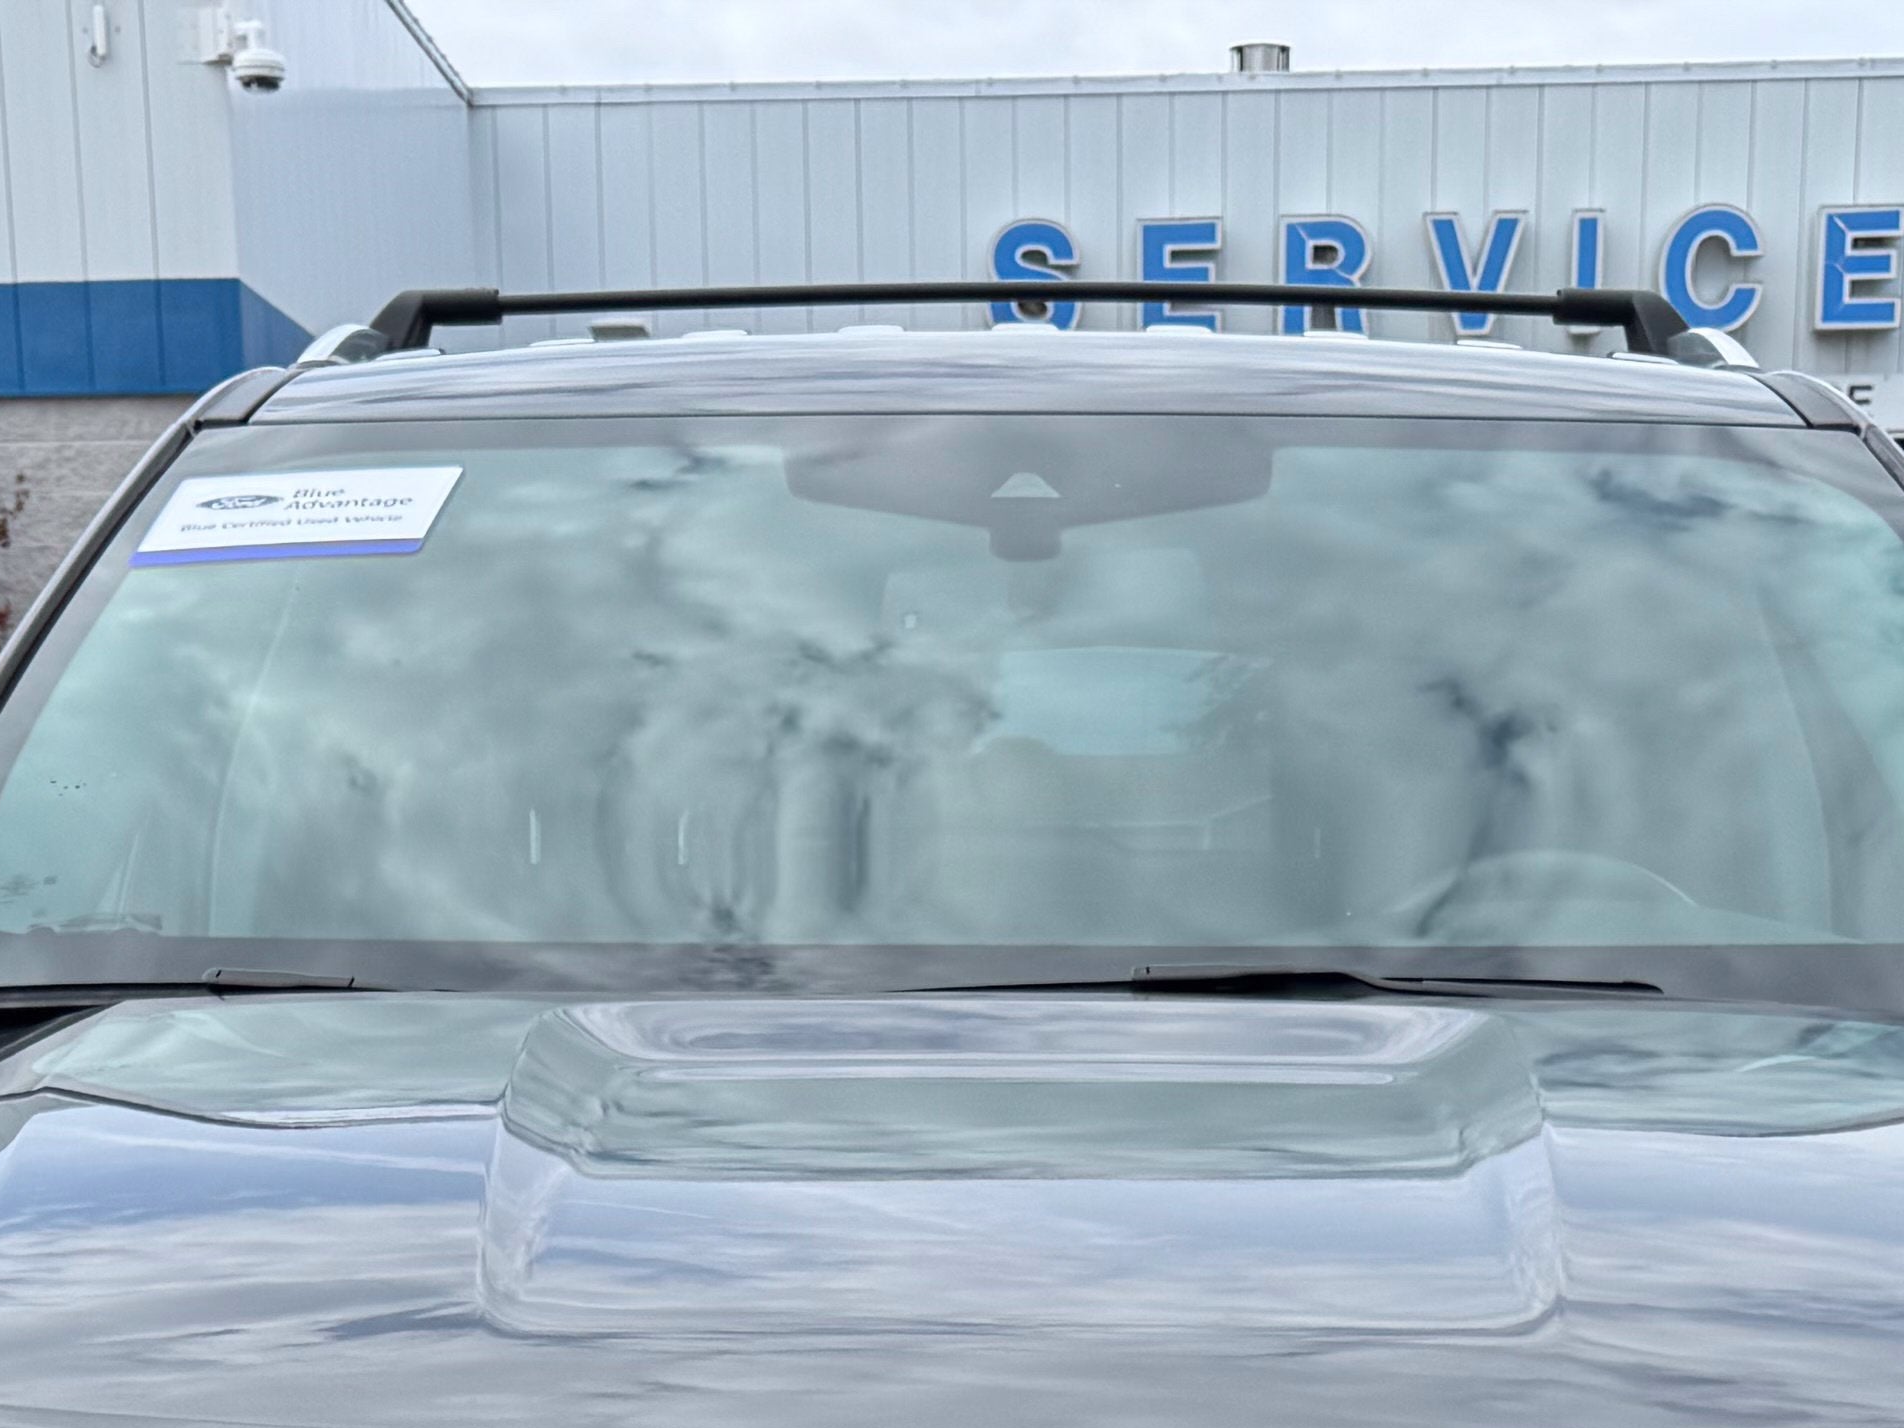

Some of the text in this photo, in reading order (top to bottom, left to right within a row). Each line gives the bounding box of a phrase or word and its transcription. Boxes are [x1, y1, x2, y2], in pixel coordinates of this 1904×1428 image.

[988, 204, 1904, 335] SERVICE
[292, 488, 345, 498] Blue
[284, 497, 413, 511] Advantage
